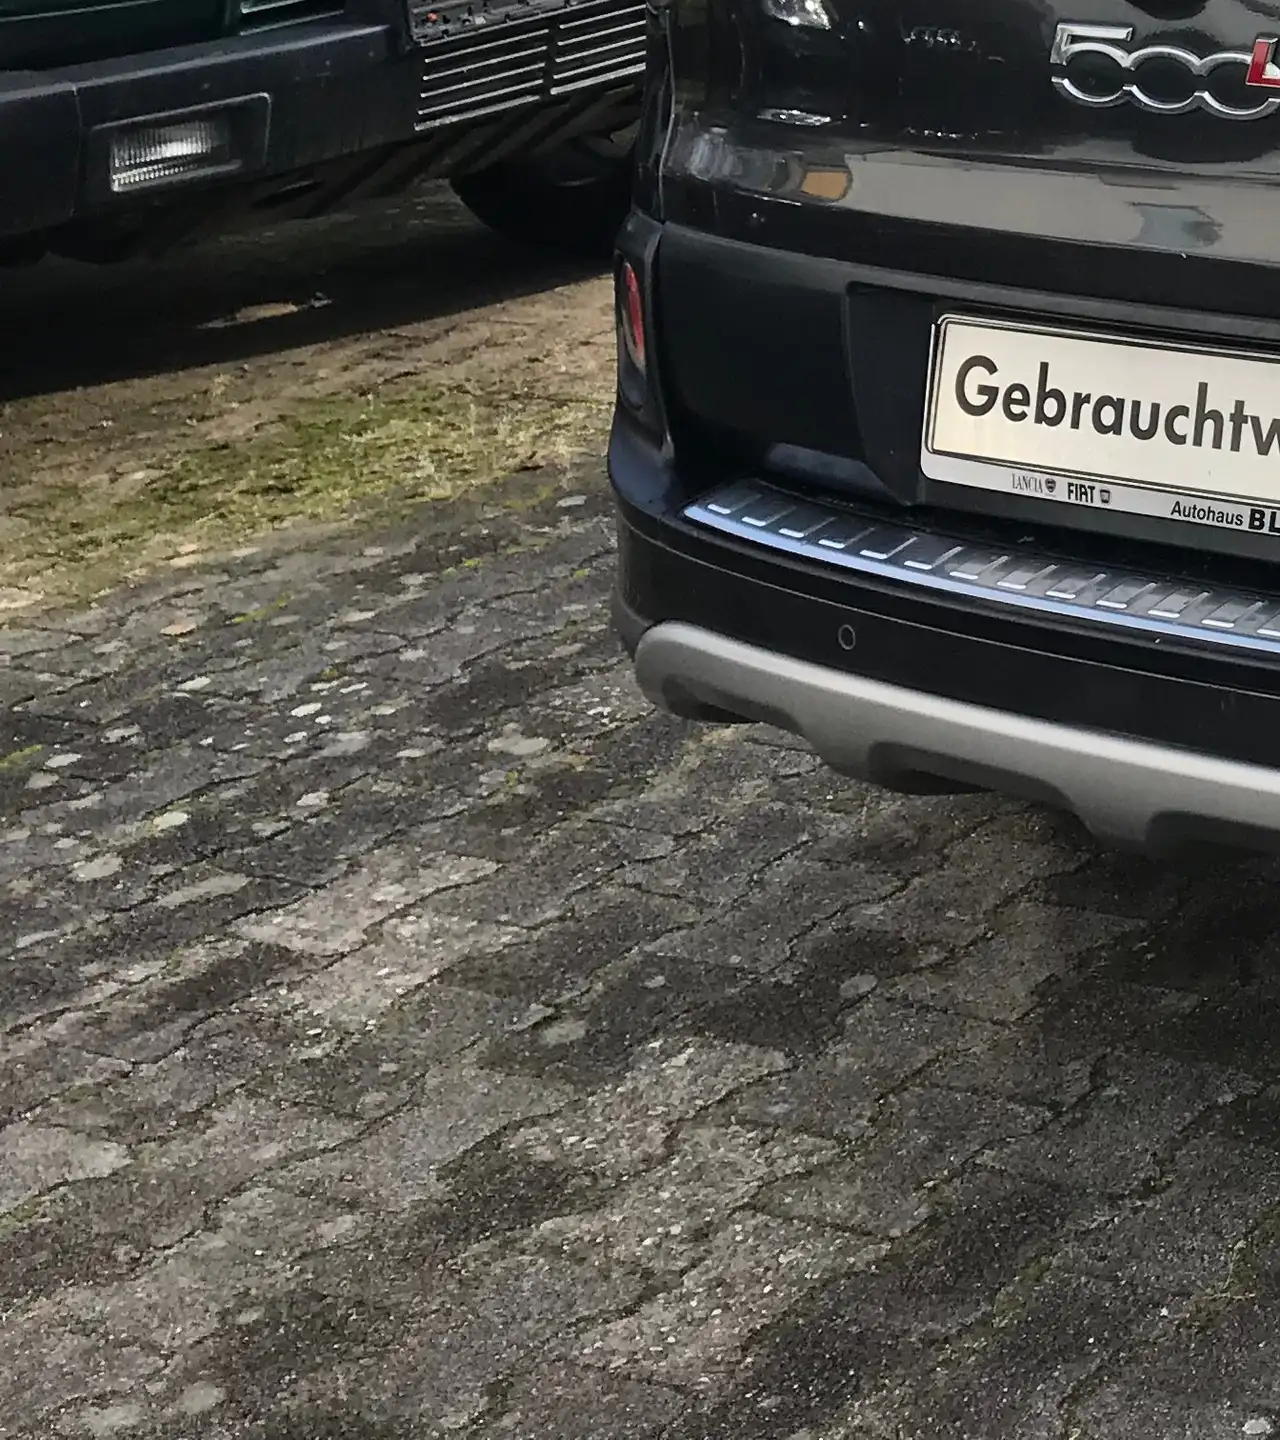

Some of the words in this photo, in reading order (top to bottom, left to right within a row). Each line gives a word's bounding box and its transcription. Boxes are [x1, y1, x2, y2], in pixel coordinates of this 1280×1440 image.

[1011, 472, 1044, 495] LANCIA
[1066, 481, 1097, 504] FIAT
[1170, 499, 1245, 527] Autohaus
